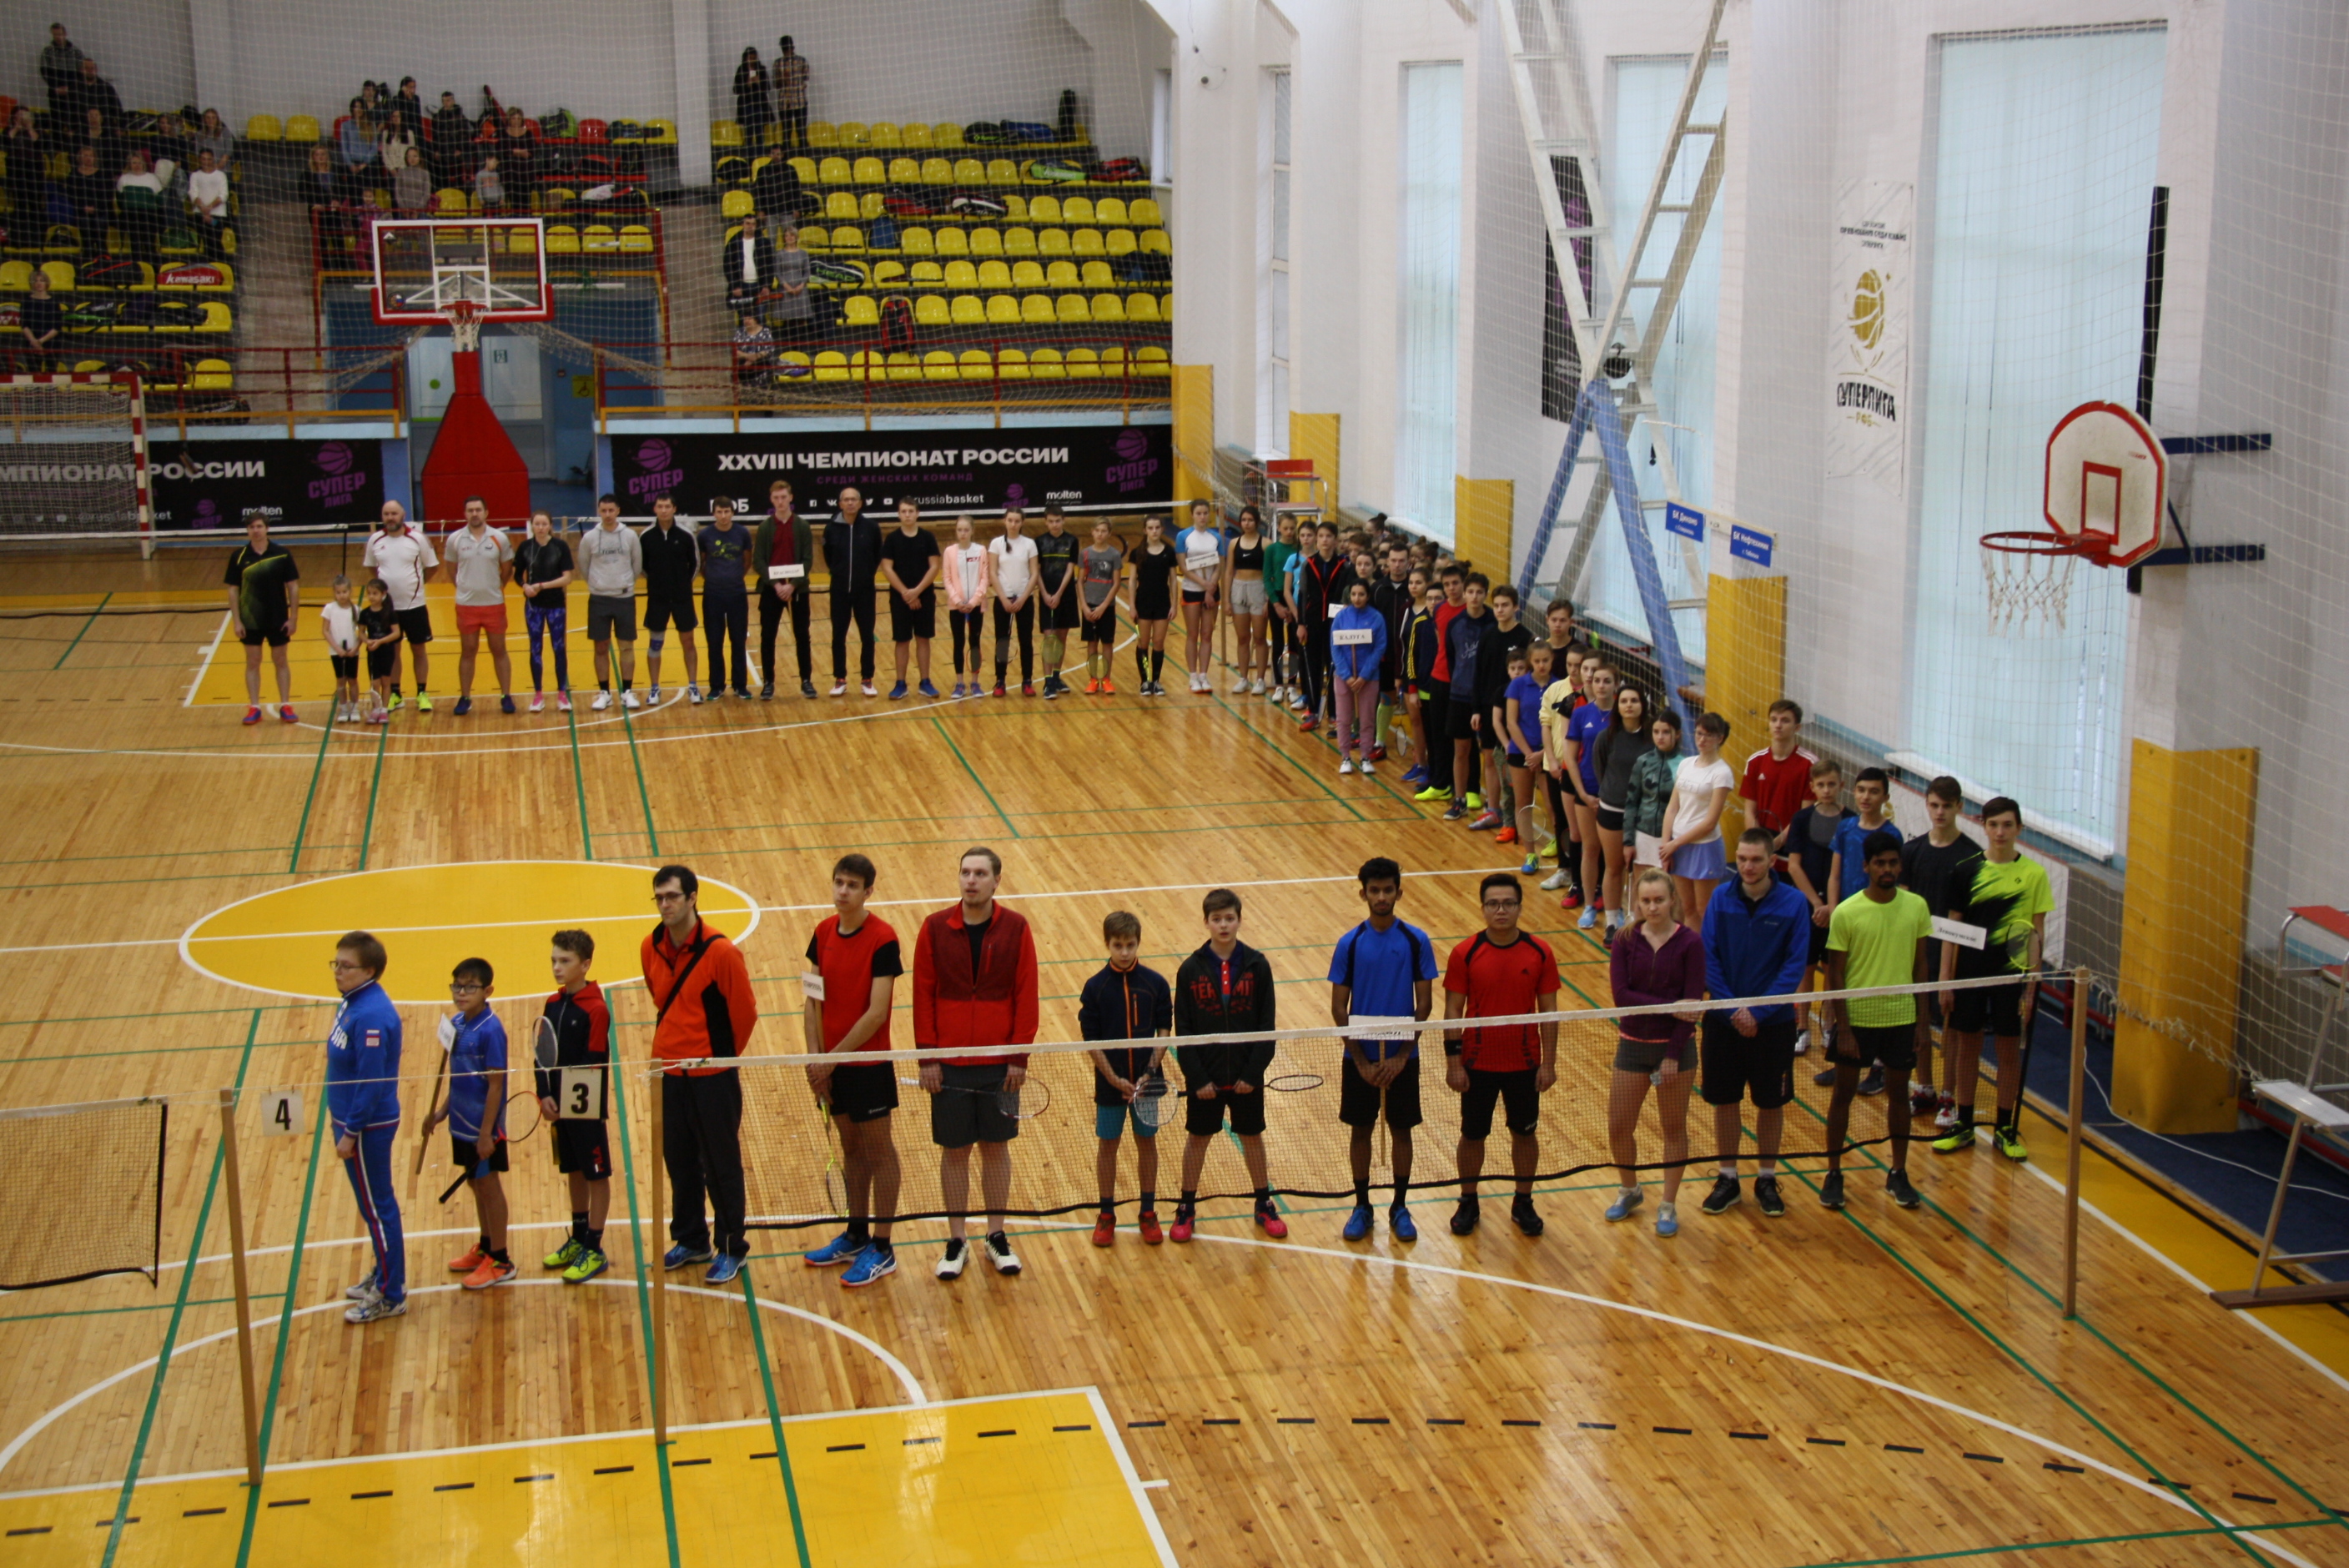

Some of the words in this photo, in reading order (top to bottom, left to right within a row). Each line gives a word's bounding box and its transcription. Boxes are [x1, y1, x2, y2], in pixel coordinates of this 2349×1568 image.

[1837, 382, 1895, 421] СУПЕРЛИГА
[718, 454, 793, 470] XXVIII
[797, 450, 958, 469] ЧЕМПИОНАТ
[963, 448, 1069, 465] РОССИИ
[149, 462, 265, 480] РОССИИ
[628, 469, 683, 495] СУПЕР
[861, 475, 918, 483] ЖЕНСКИХ
[923, 473, 973, 481] КОМАНД
[1106, 459, 1158, 483] СУПЕР
[308, 472, 365, 498] СУПЕР
[1047, 490, 1082, 499] molten
[1120, 479, 1145, 492] ЛИГА
[324, 494, 353, 508] ЛИГА
[571, 1083, 589, 1114] 3
[275, 1098, 292, 1130] 4
